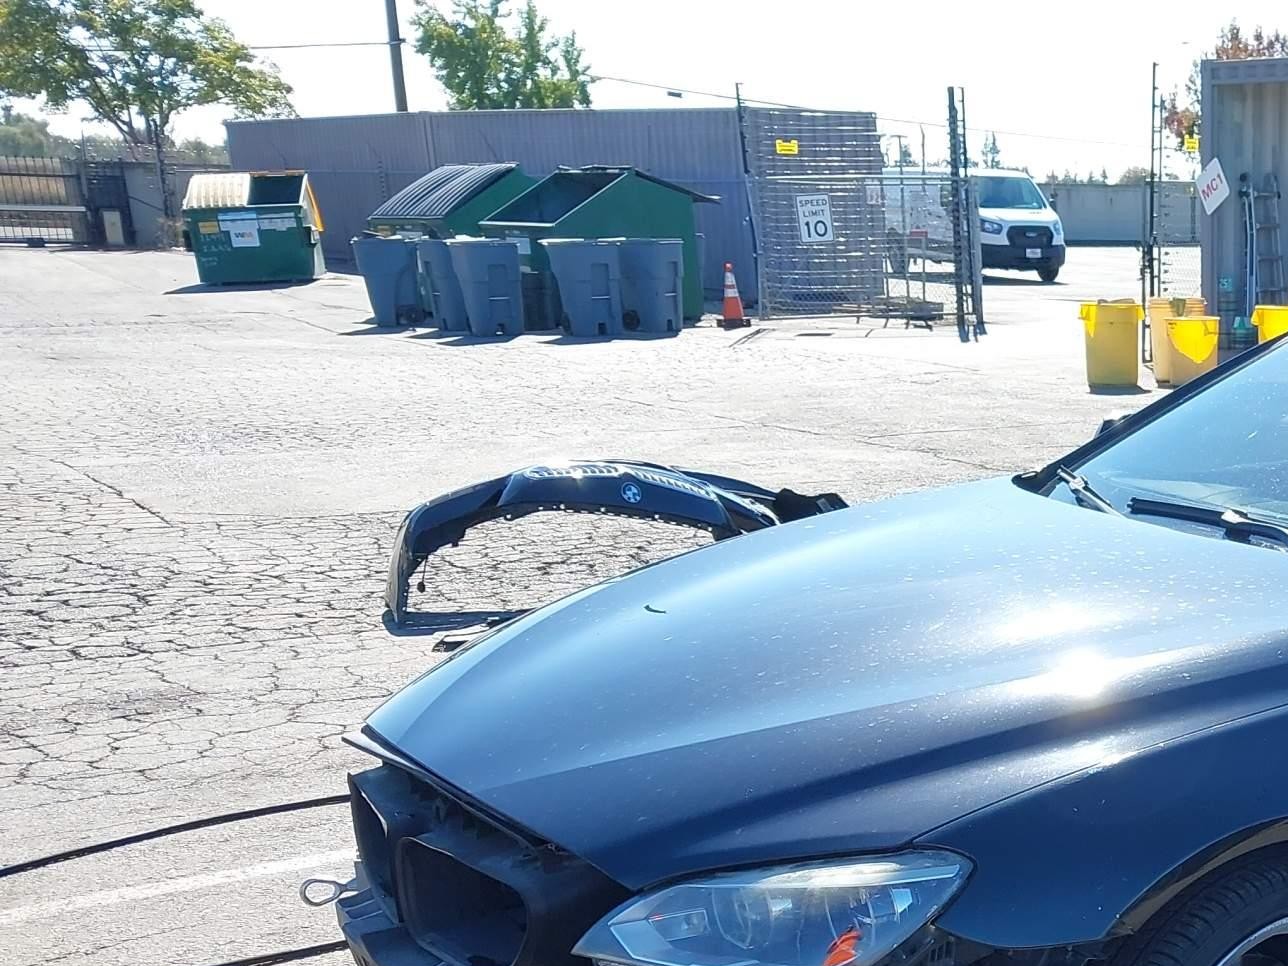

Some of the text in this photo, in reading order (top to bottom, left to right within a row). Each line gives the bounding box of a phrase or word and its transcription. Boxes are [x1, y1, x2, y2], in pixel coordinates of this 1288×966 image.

[1201, 173, 1223, 201] MC1
[798, 199, 827, 207] SPEED
[802, 209, 825, 217] LIMIT
[804, 220, 828, 238] 10
